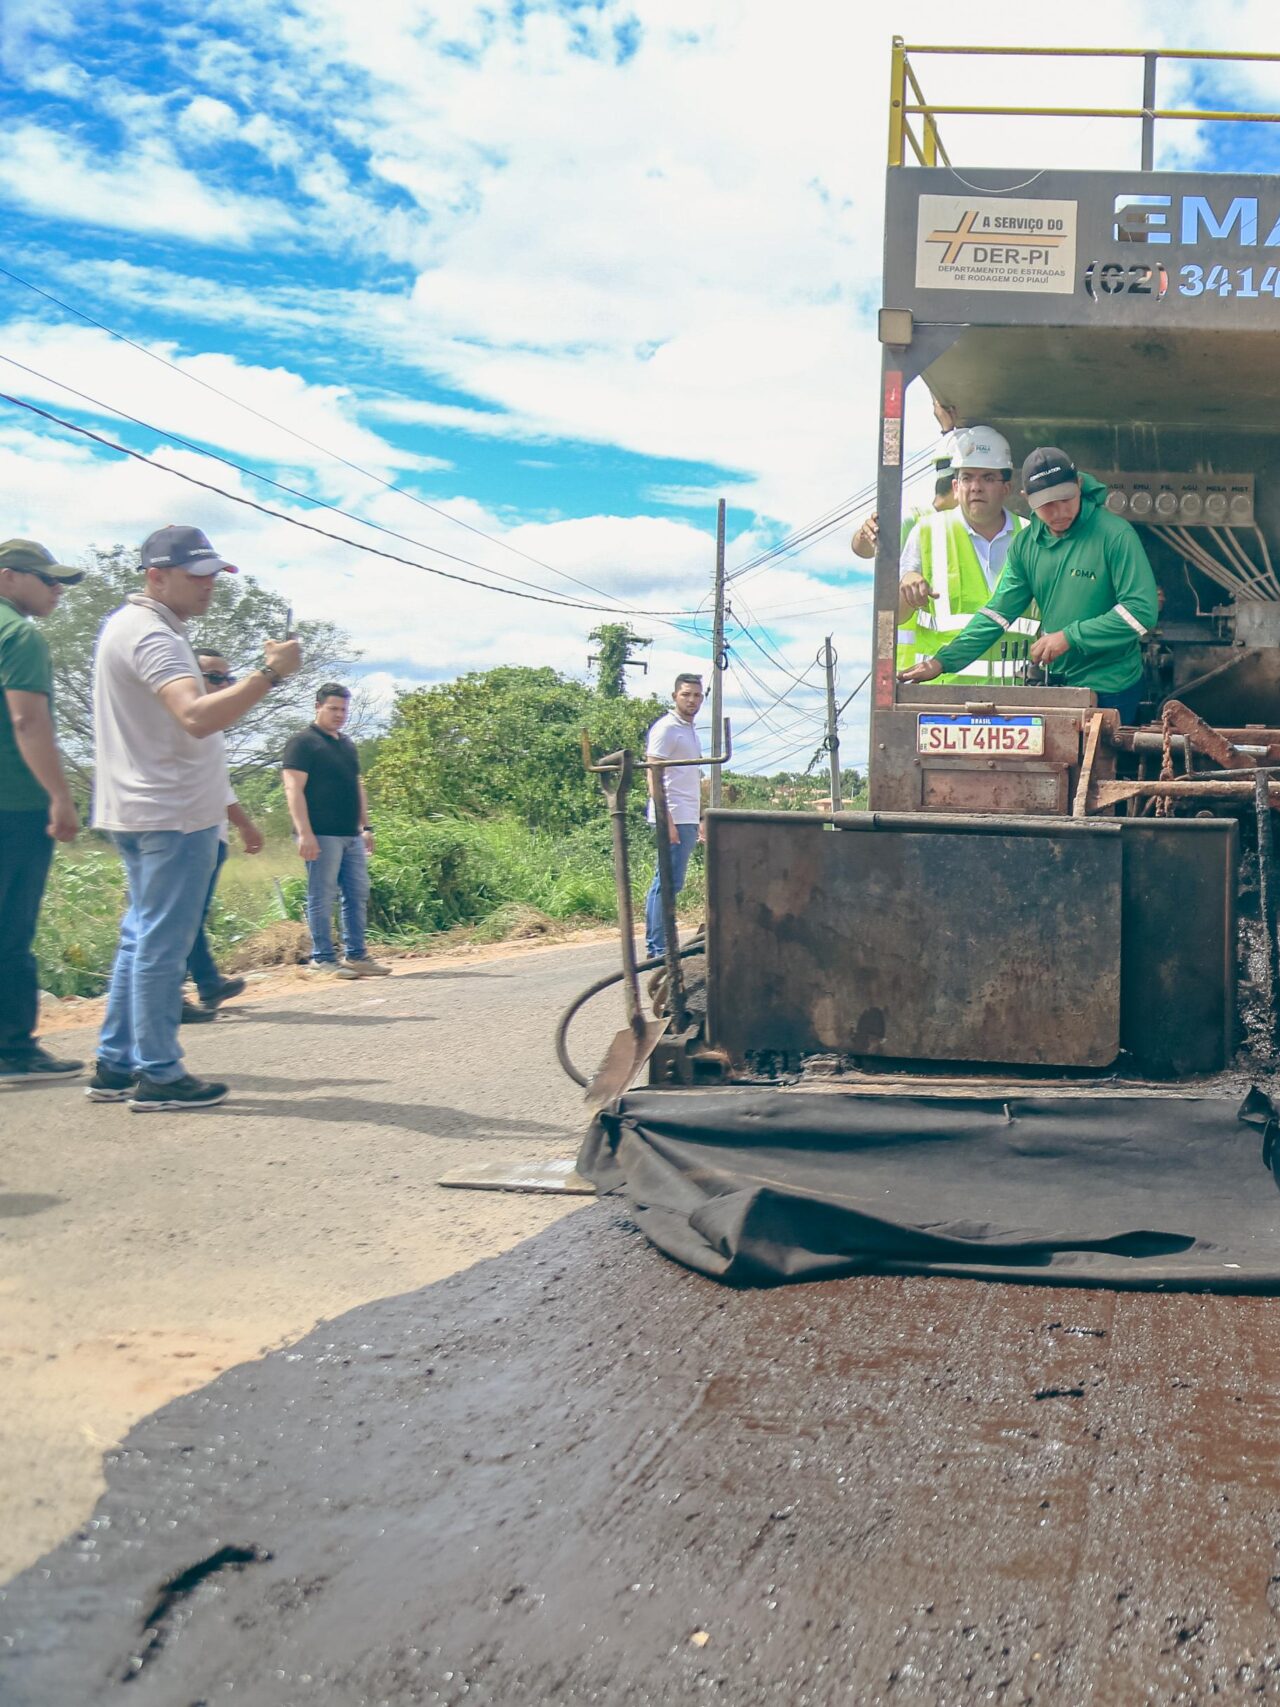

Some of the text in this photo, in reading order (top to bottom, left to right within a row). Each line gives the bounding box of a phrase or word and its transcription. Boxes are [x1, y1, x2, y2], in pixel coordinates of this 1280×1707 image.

[982, 216, 1063, 233] A SERVIÇO DO
[973, 247, 1049, 265] DER-PI
[938, 265, 1005, 274] DEPARTAMENTO
[1021, 269, 1066, 277] ESTRADAS
[968, 275, 1010, 283] RODAGEM
[1027, 276, 1049, 284] PIAUÍ
[1085, 260, 1168, 302] (62)
[930, 727, 1030, 750] SLT4H52
